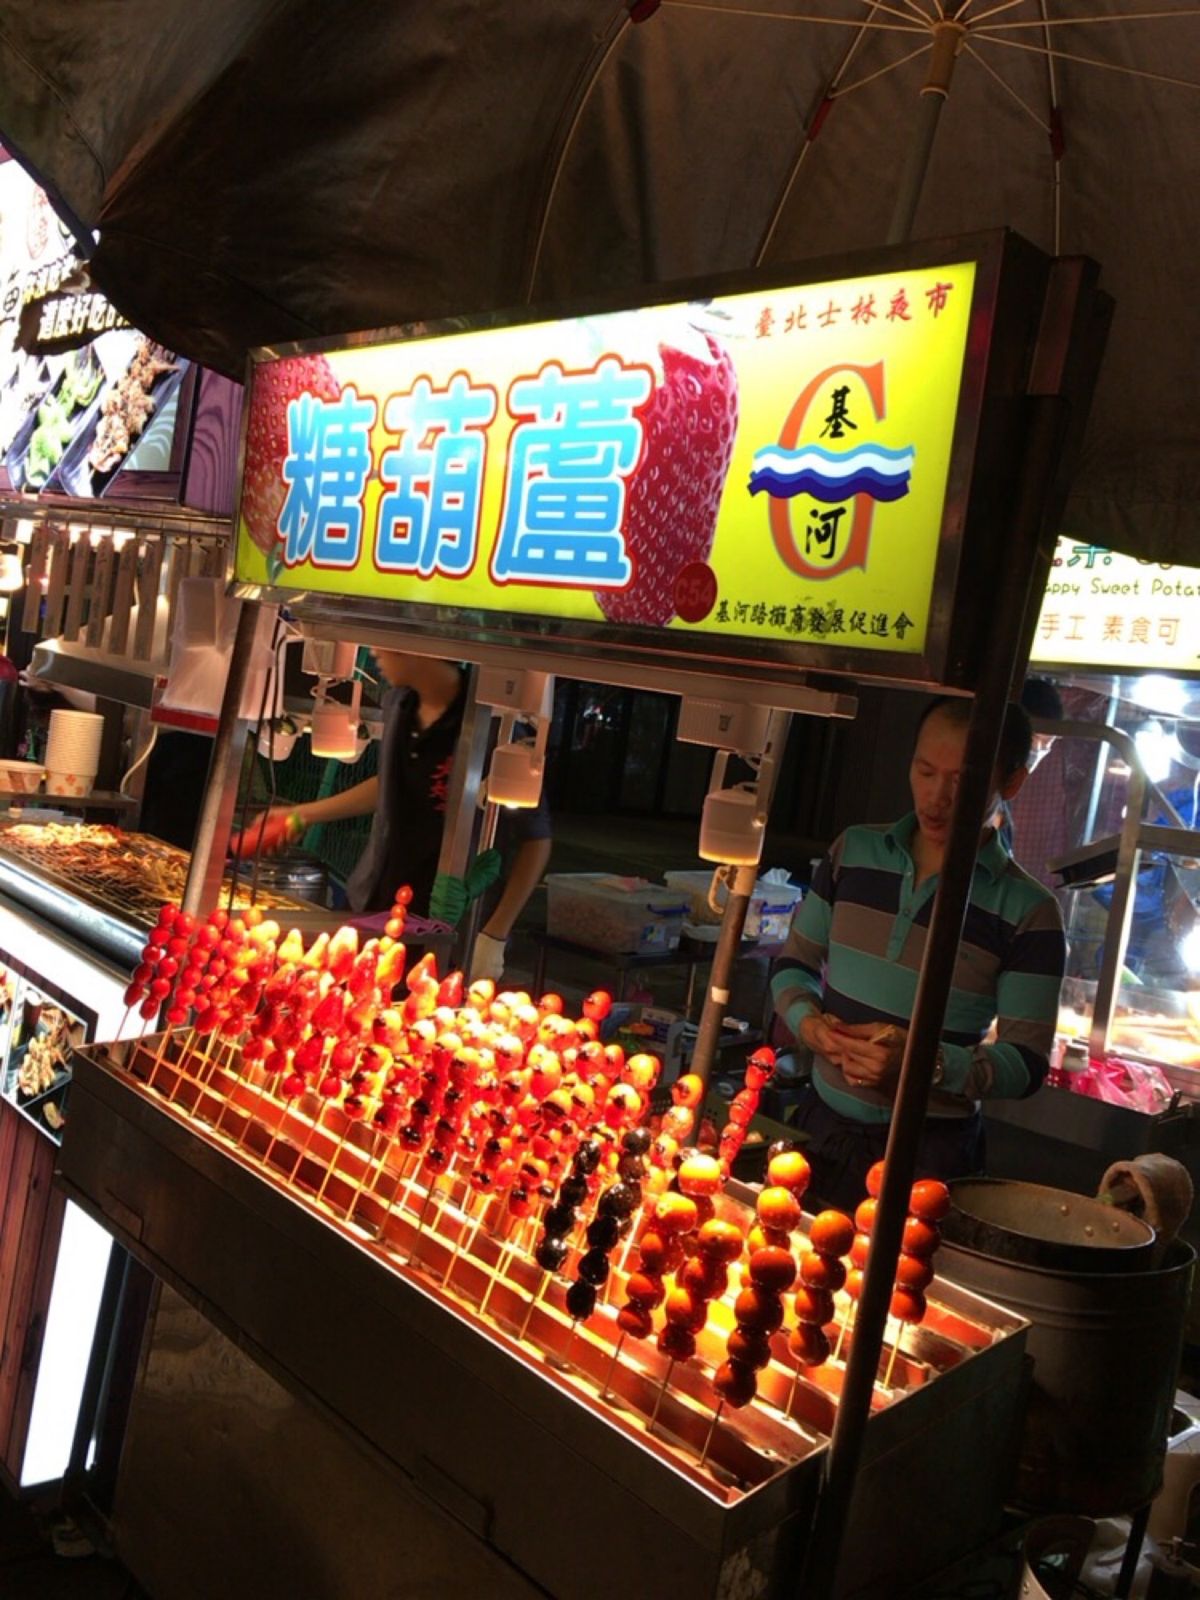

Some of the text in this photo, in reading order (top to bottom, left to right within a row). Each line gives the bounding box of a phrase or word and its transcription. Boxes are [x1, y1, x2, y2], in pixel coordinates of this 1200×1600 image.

[755, 282, 953, 339] 臺北士林夜市
[278, 353, 655, 590] 糖葫蘆
[1091, 577, 1139, 595] Sweet
[1040, 614, 1181, 645] 手工 素食可
